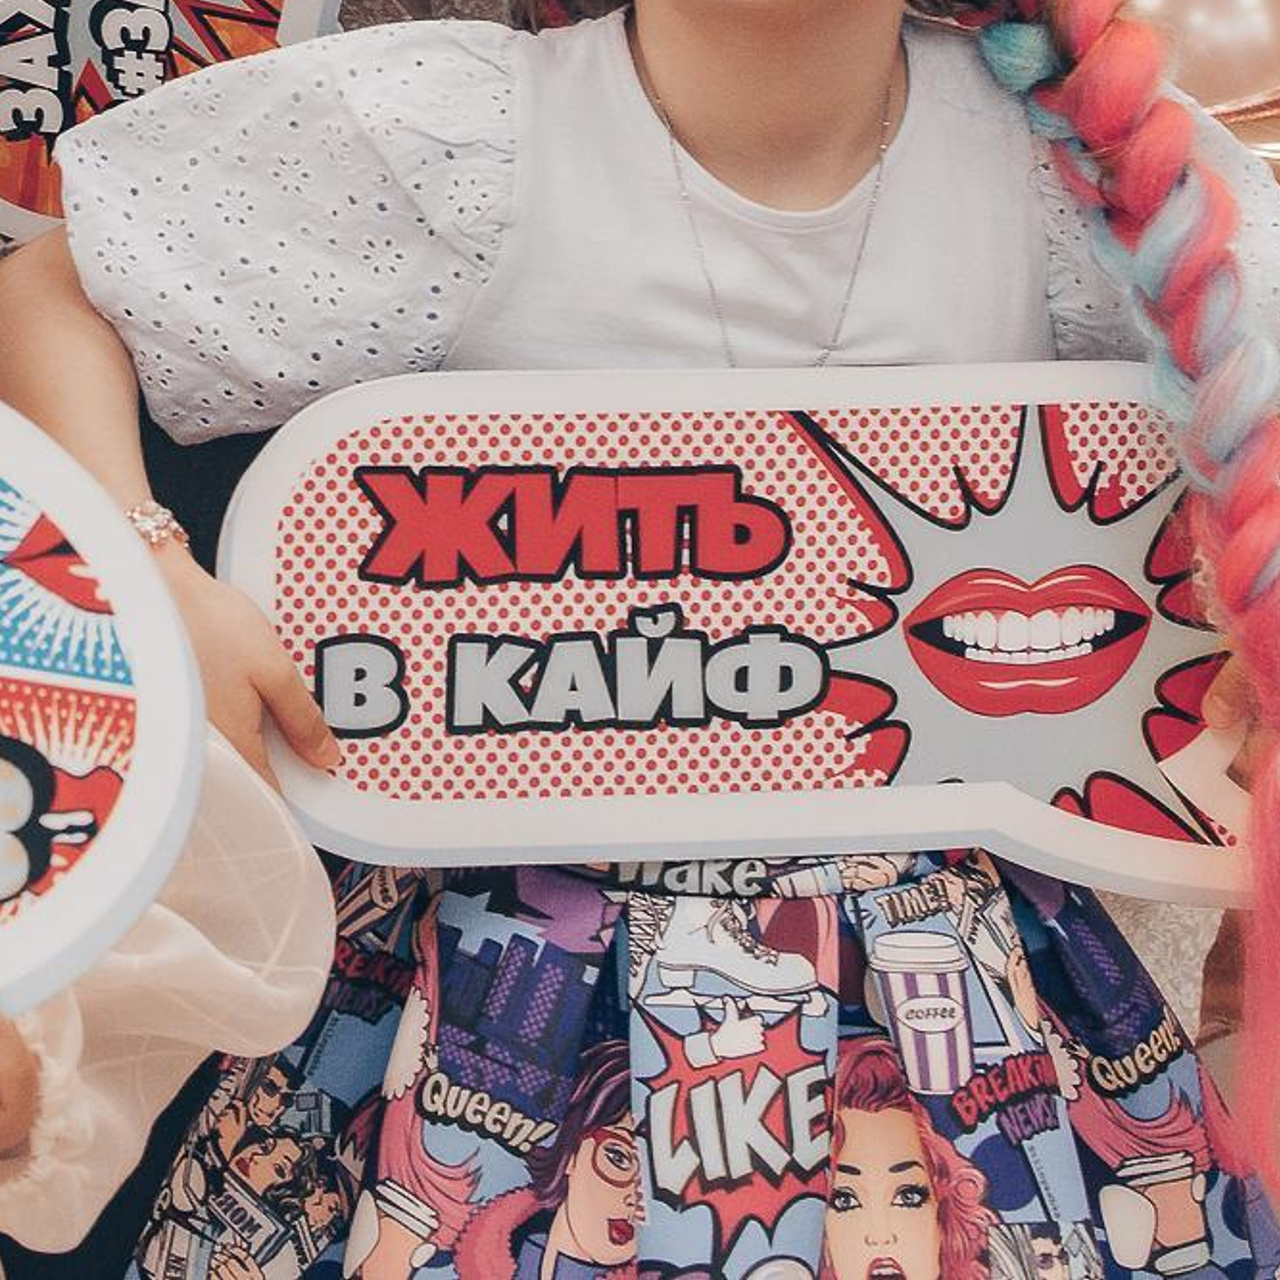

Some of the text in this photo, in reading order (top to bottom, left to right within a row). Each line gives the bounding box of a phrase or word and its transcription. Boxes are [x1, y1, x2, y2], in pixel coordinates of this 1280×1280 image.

[356, 466, 793, 587] ЖИТЬ
[321, 603, 831, 737] В КАЙФ
[875, 877, 950, 926] TIME!
[421, 1071, 558, 1153] Queen!
[649, 1064, 833, 1196] LIKE
